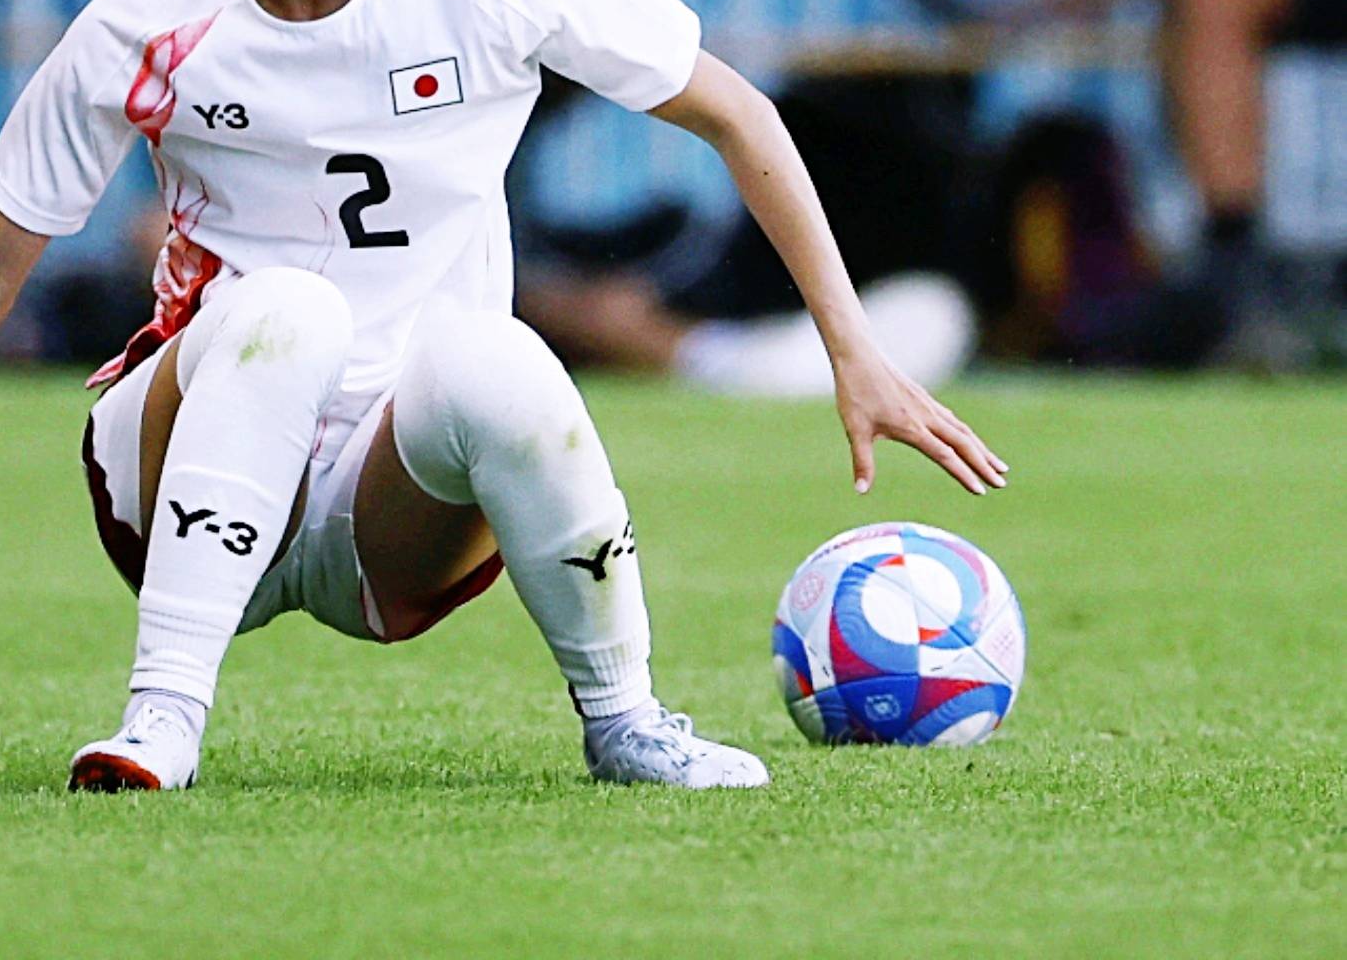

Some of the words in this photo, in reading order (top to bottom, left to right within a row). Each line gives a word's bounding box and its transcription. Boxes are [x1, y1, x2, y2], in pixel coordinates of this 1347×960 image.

[191, 103, 250, 130] Y-3
[325, 153, 410, 249] 2
[168, 500, 259, 556] Y-3
